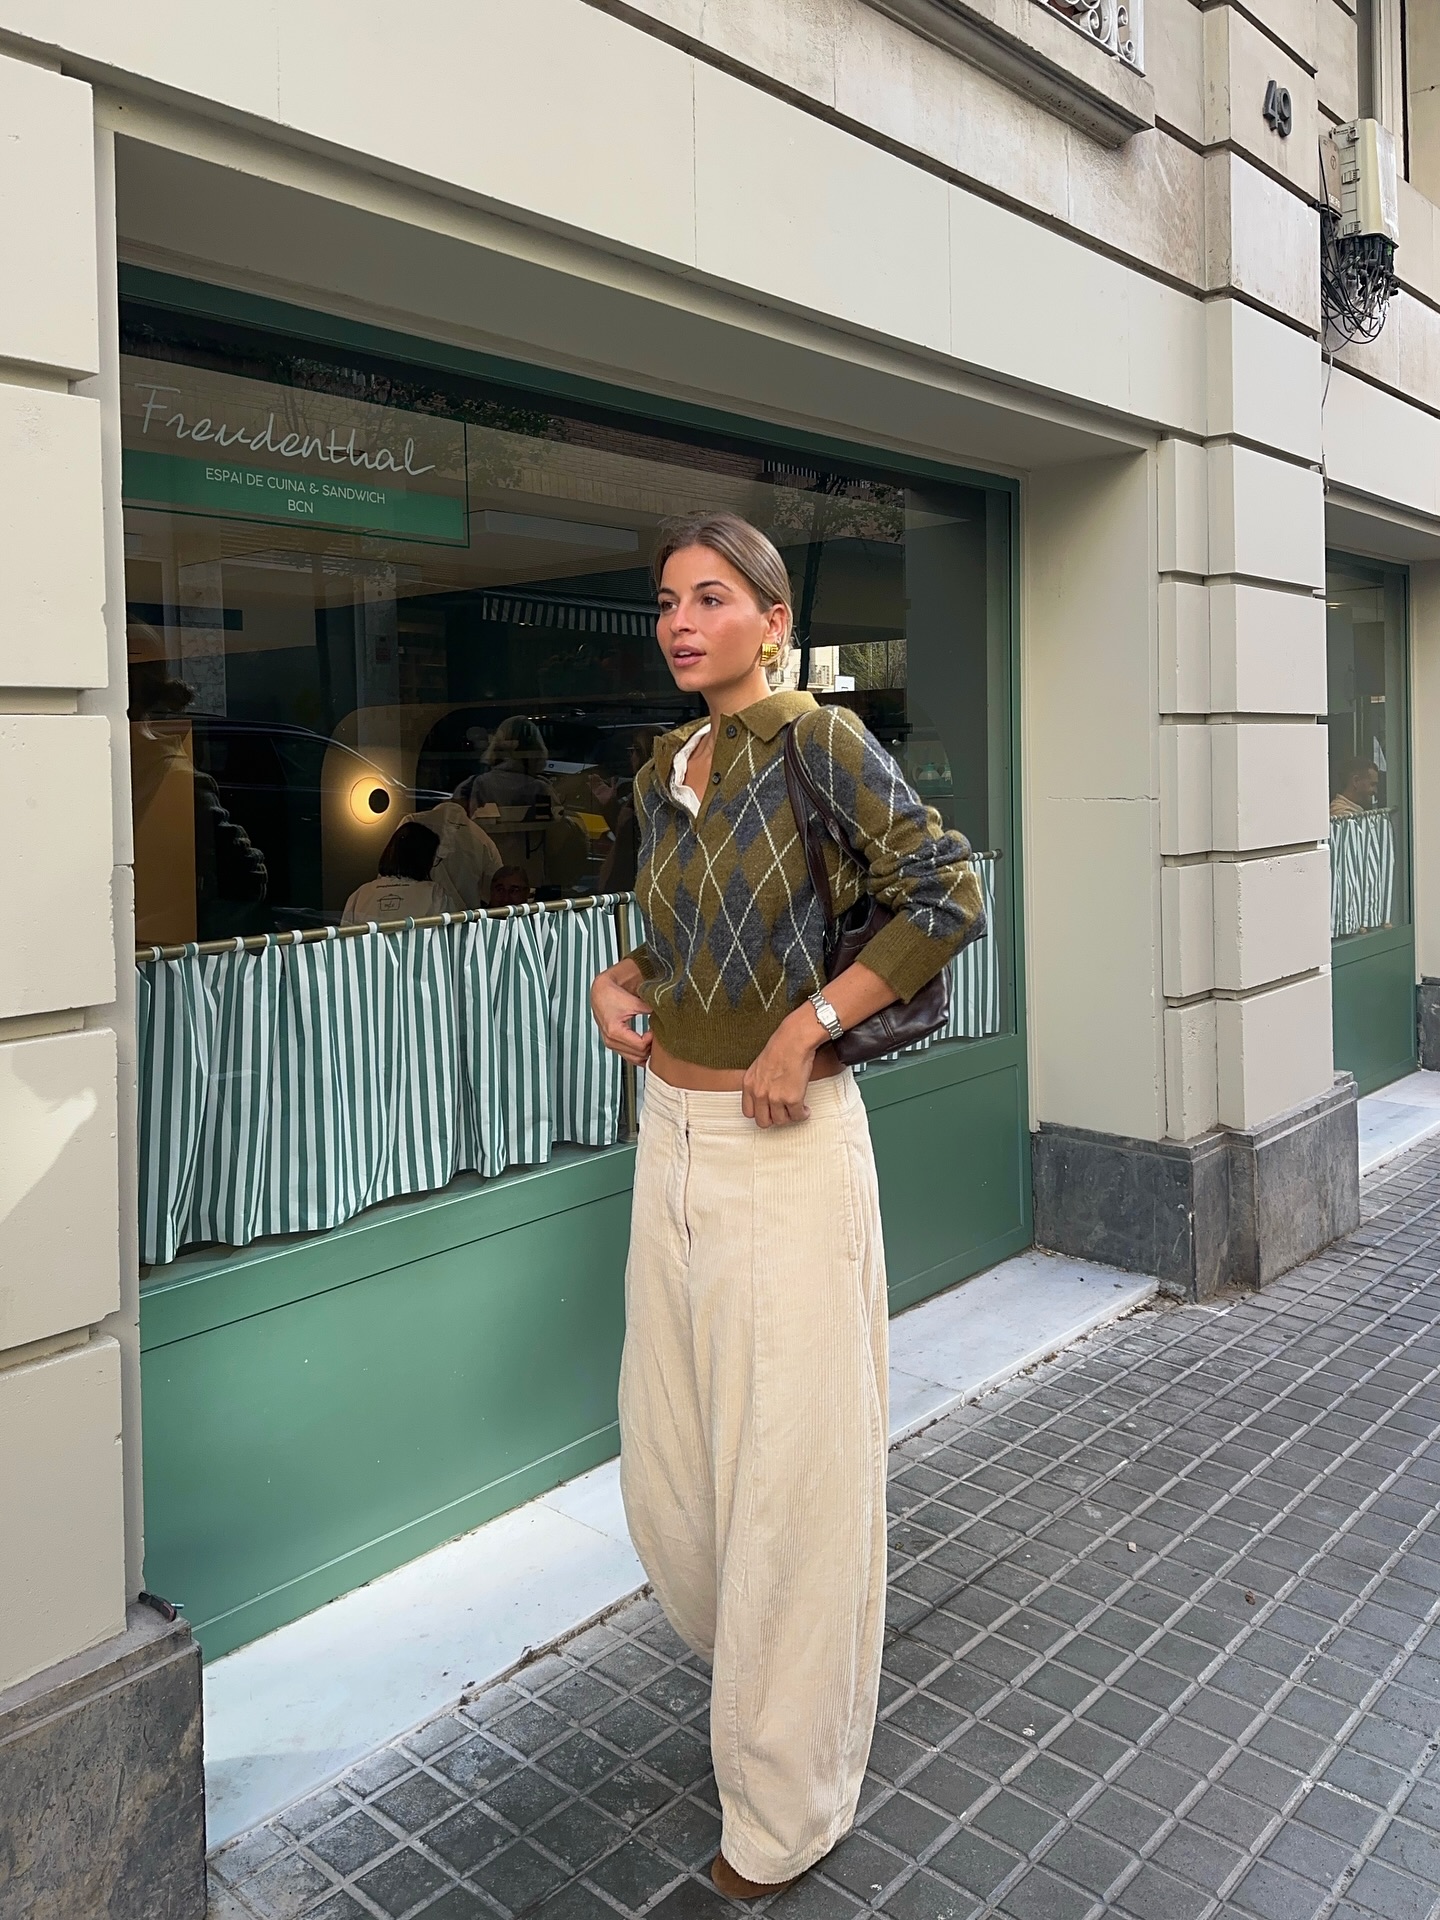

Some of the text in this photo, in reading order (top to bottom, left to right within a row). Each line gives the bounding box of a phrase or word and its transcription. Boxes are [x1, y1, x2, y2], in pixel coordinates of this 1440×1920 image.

[1263, 80, 1292, 137] 49
[134, 383, 436, 476] Freudenthal
[206, 467, 386, 504] ESPAI DE CUINA & SANDWICH
[288, 499, 314, 514] BCN
